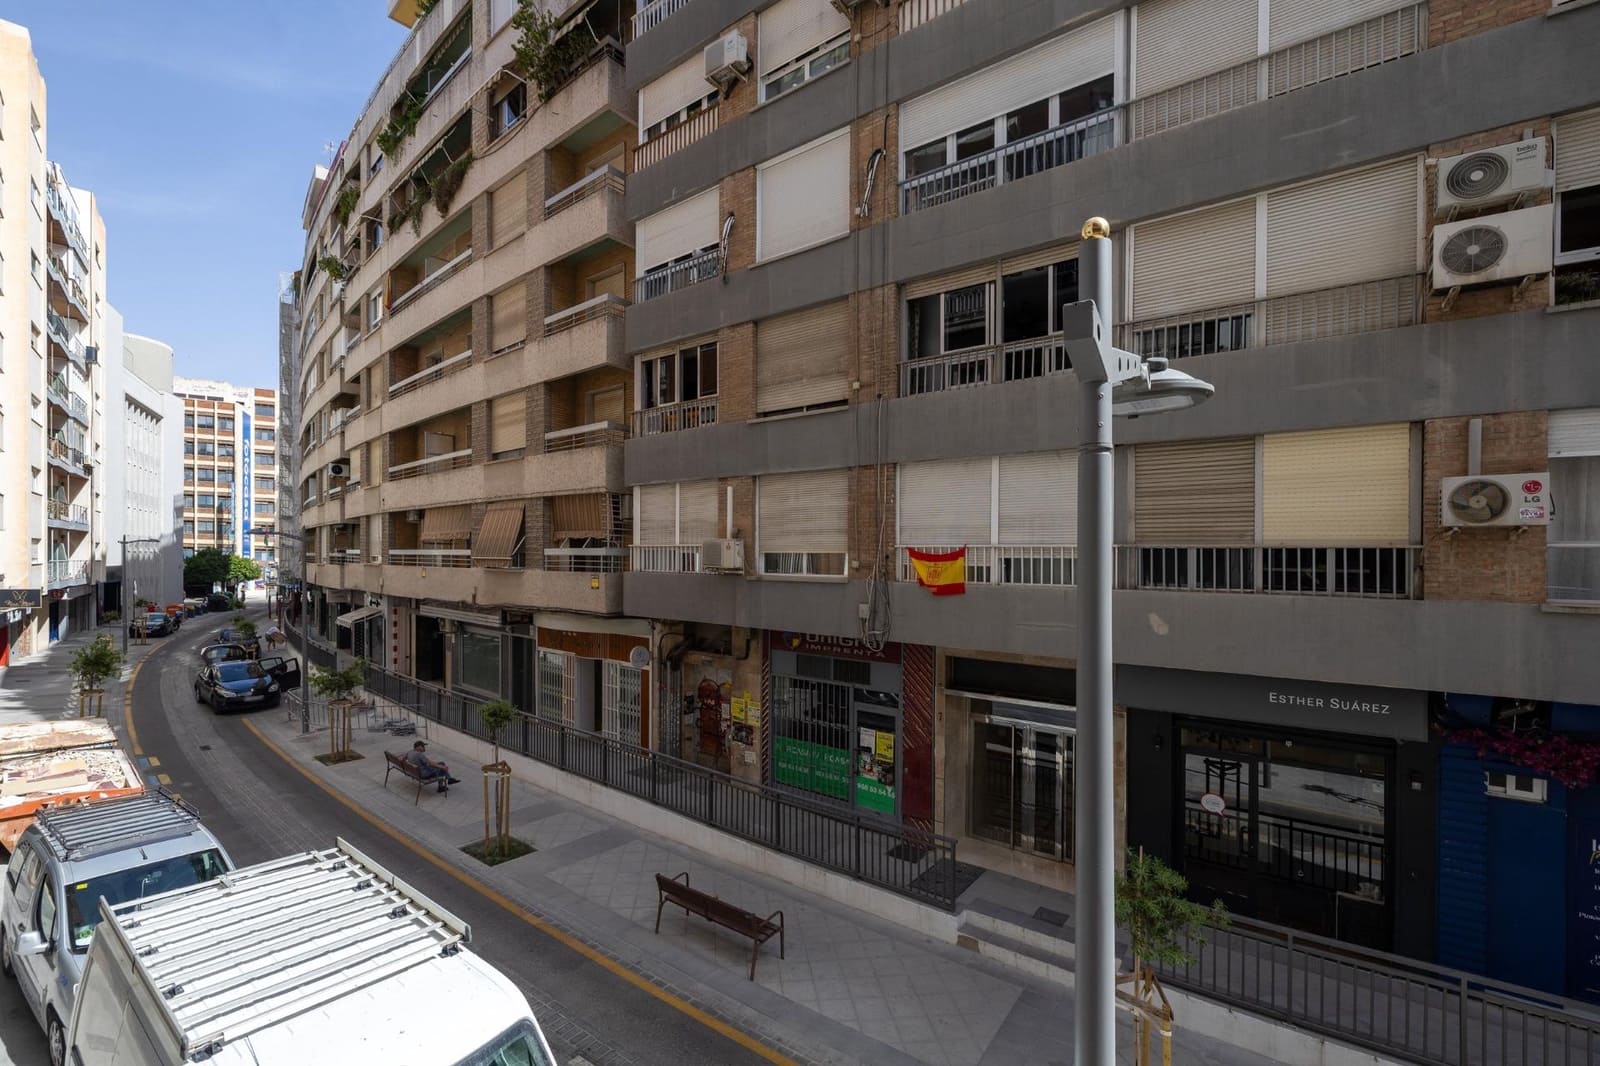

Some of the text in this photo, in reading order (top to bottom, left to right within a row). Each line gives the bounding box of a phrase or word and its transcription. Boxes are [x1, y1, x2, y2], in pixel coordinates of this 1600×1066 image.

[1524, 495, 1540, 503] LG
[805, 643, 885, 659] IMPRENTA
[1269, 692, 1391, 714] ESTHER SUÁREZ
